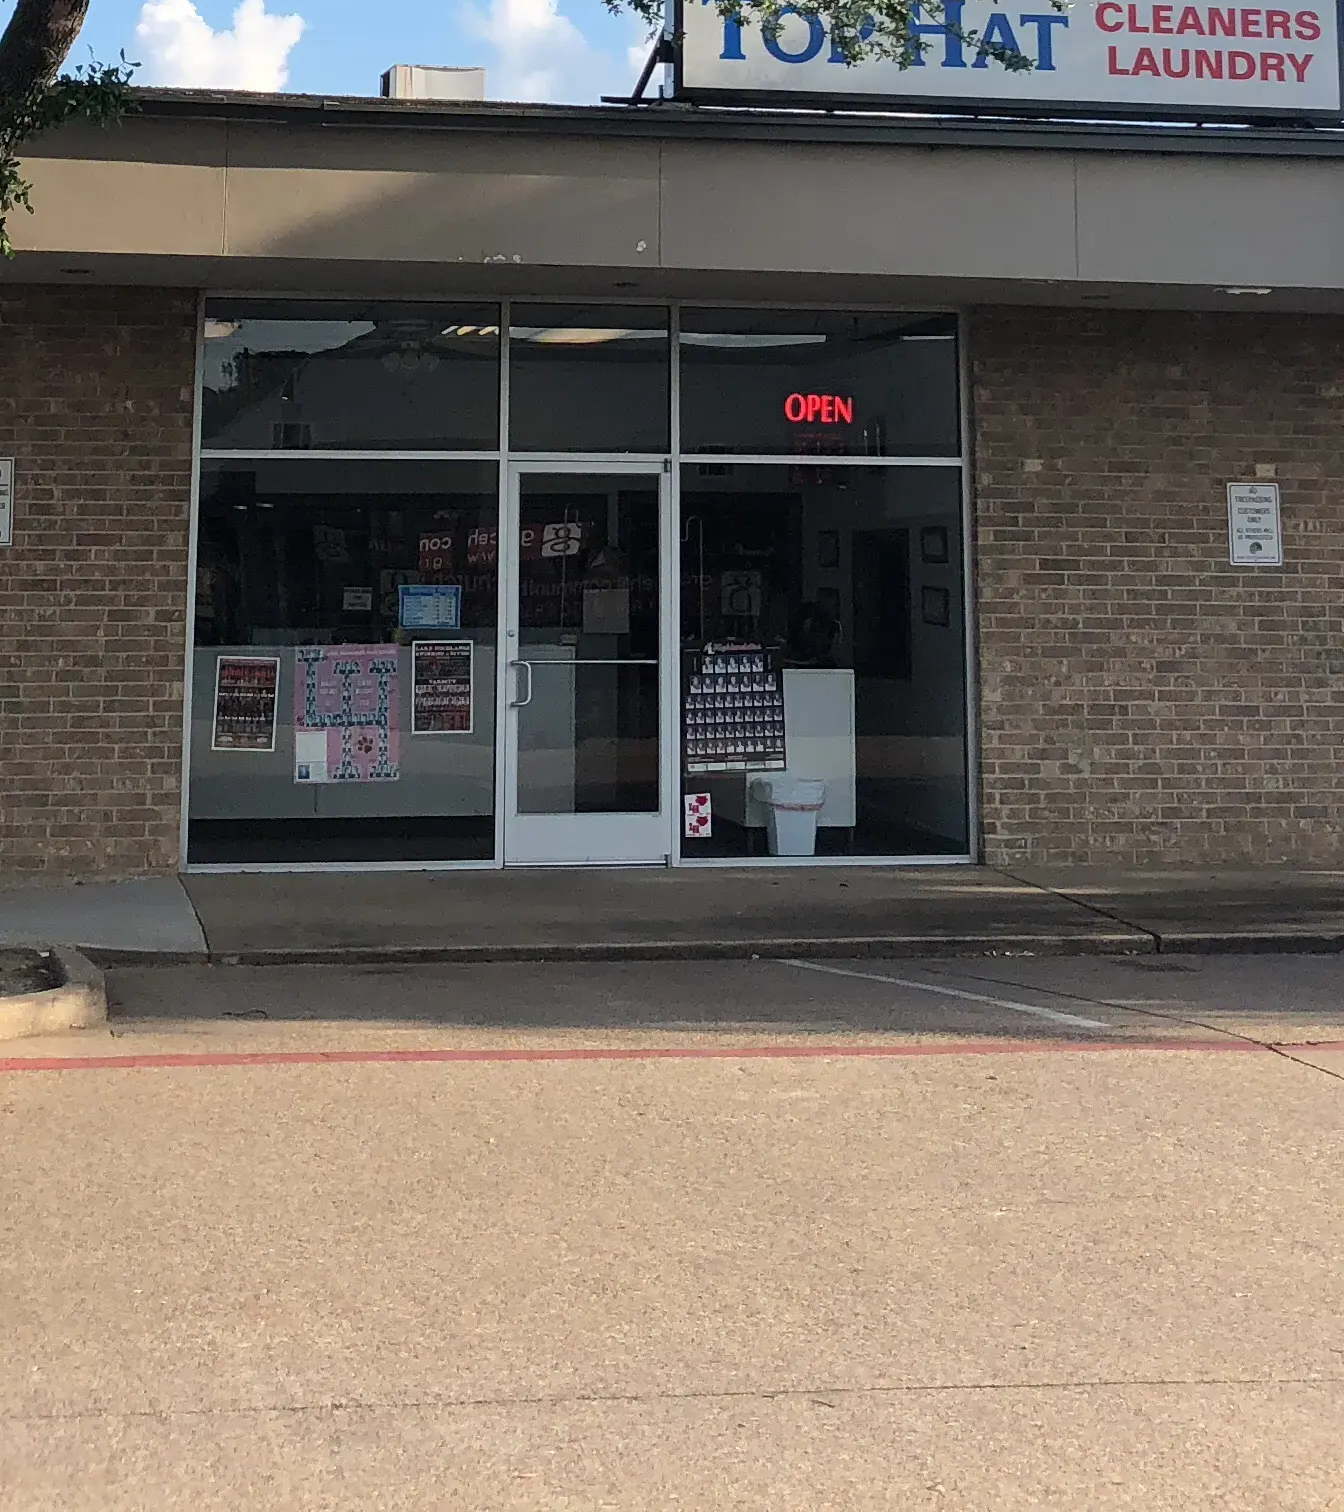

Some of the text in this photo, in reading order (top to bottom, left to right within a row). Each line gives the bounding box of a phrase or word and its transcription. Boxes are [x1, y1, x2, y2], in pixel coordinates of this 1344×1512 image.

[1094, 2, 1321, 41] CLEANERS
[1107, 45, 1315, 84] LAUNDRY
[784, 392, 853, 424] OPEN
